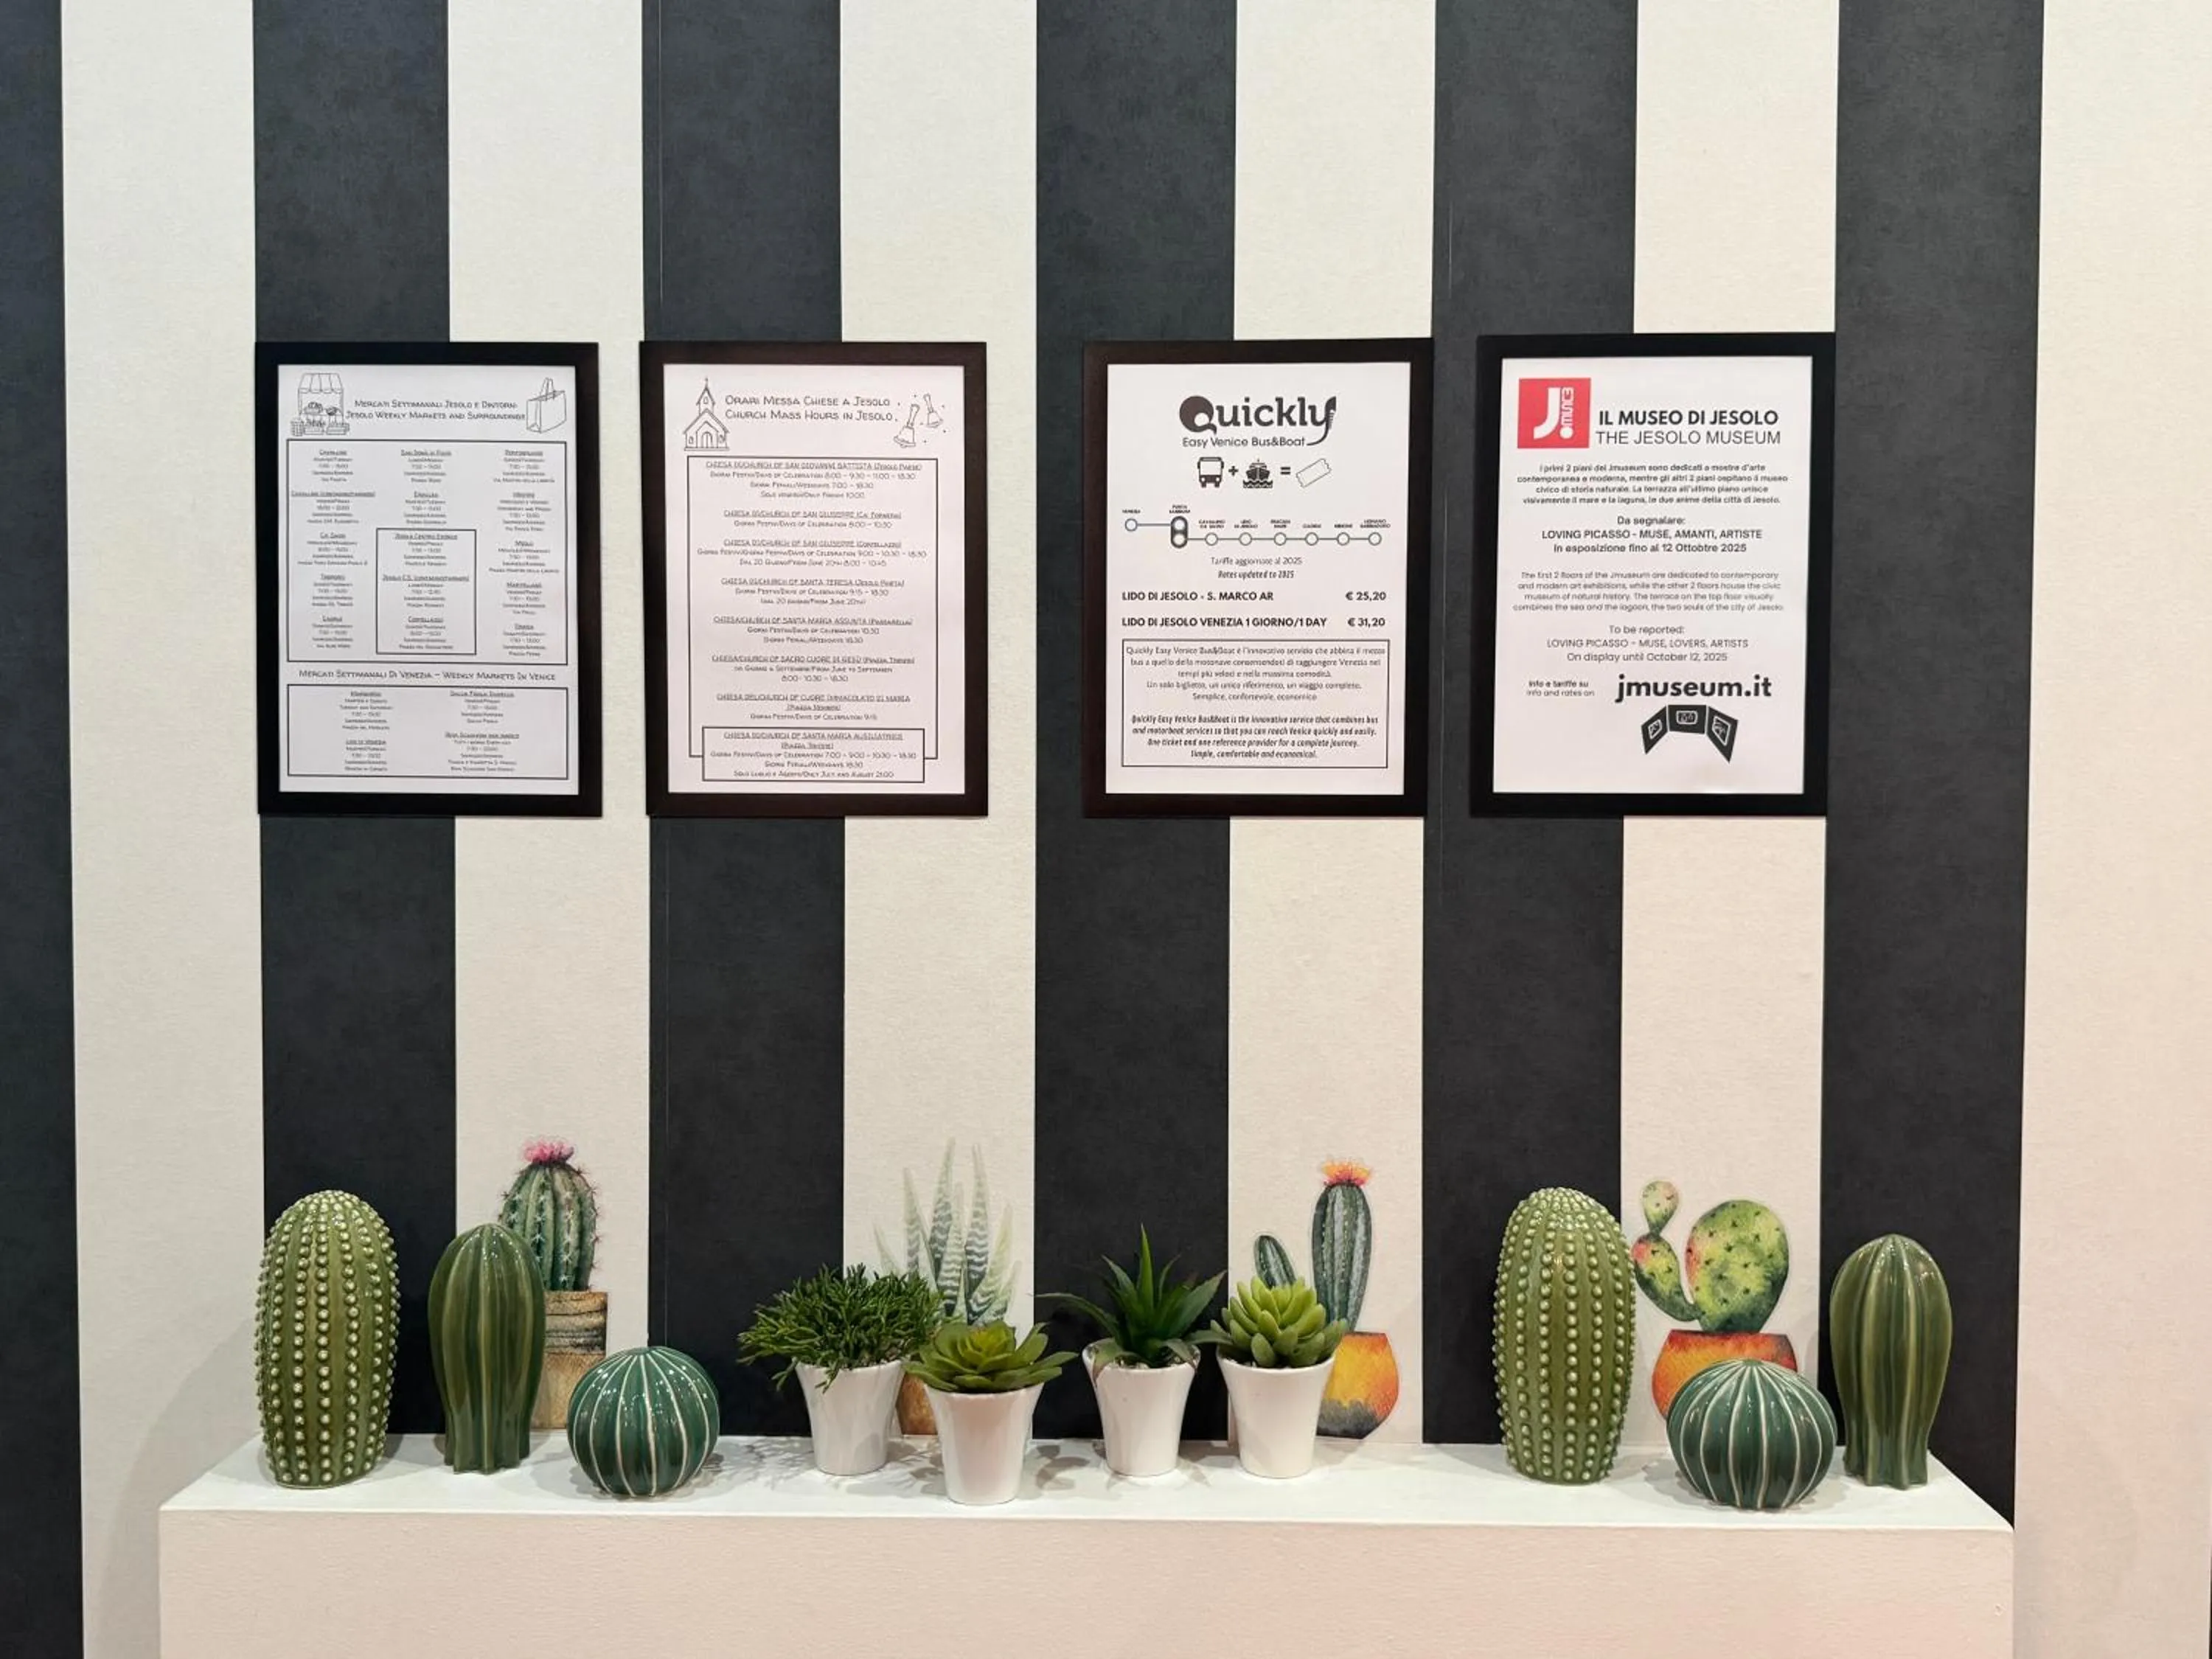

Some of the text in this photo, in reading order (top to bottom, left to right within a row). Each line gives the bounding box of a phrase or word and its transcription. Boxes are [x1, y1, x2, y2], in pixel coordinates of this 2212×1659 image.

[725, 395, 760, 405] ORARI
[763, 396, 800, 406] MESSA
[803, 396, 838, 406] CHIESE
[853, 397, 890, 406] JESOLO
[725, 409, 766, 419] CHURCH
[770, 410, 801, 420] MASS
[804, 410, 839, 420] HOURS
[855, 411, 892, 421] JESOLO
[1179, 395, 1336, 446] Quickly
[1599, 409, 1778, 425] IL MUSEO DI JESOLO
[1182, 436, 1307, 448] Easy Venice Bus&Boat
[1595, 430, 1781, 444] THE JESOLO MUSEUM
[1617, 515, 1686, 526] Da segnalare:
[1542, 529, 1582, 539] LOVING
[1583, 529, 1630, 538] PICASSO
[1639, 529, 1672, 539] MUSE,
[1674, 529, 1717, 539] AMANTI,
[1719, 529, 1762, 538] ARTISTE
[1554, 543, 1563, 552] In
[1565, 543, 1626, 554] esposizione
[1629, 543, 1648, 552] fino
[1649, 543, 1659, 552] al
[1662, 543, 1672, 552] 12
[1720, 543, 1746, 552] 2025
[1121, 591, 1146, 600] LIDO
[1147, 591, 1158, 600] DI
[1160, 591, 1198, 600] JESOLO
[1207, 591, 1216, 600] S.
[1218, 591, 1257, 600] MARCO
[1259, 591, 1273, 600] AR
[1356, 591, 1386, 601] 25,20
[1121, 617, 1145, 626] LIDO
[1147, 617, 1158, 626] DI
[1159, 617, 1197, 627] JESOLO
[1200, 617, 1243, 627] VENEZIA
[1251, 617, 1304, 627] GIORNO/1
[1305, 617, 1327, 627] DAY
[1357, 617, 1385, 627] 31,20
[1609, 625, 1684, 636] To be reported:
[1546, 639, 1584, 647] LOVING
[1585, 639, 1628, 647] PICASSO
[1638, 639, 1666, 648] MUSE,
[1669, 639, 1708, 647] LOVERS,
[1710, 639, 1748, 647] ARTISTS
[1567, 652, 1728, 664] On display until October 12, 2025
[1615, 673, 1771, 703] jmuseum.it
